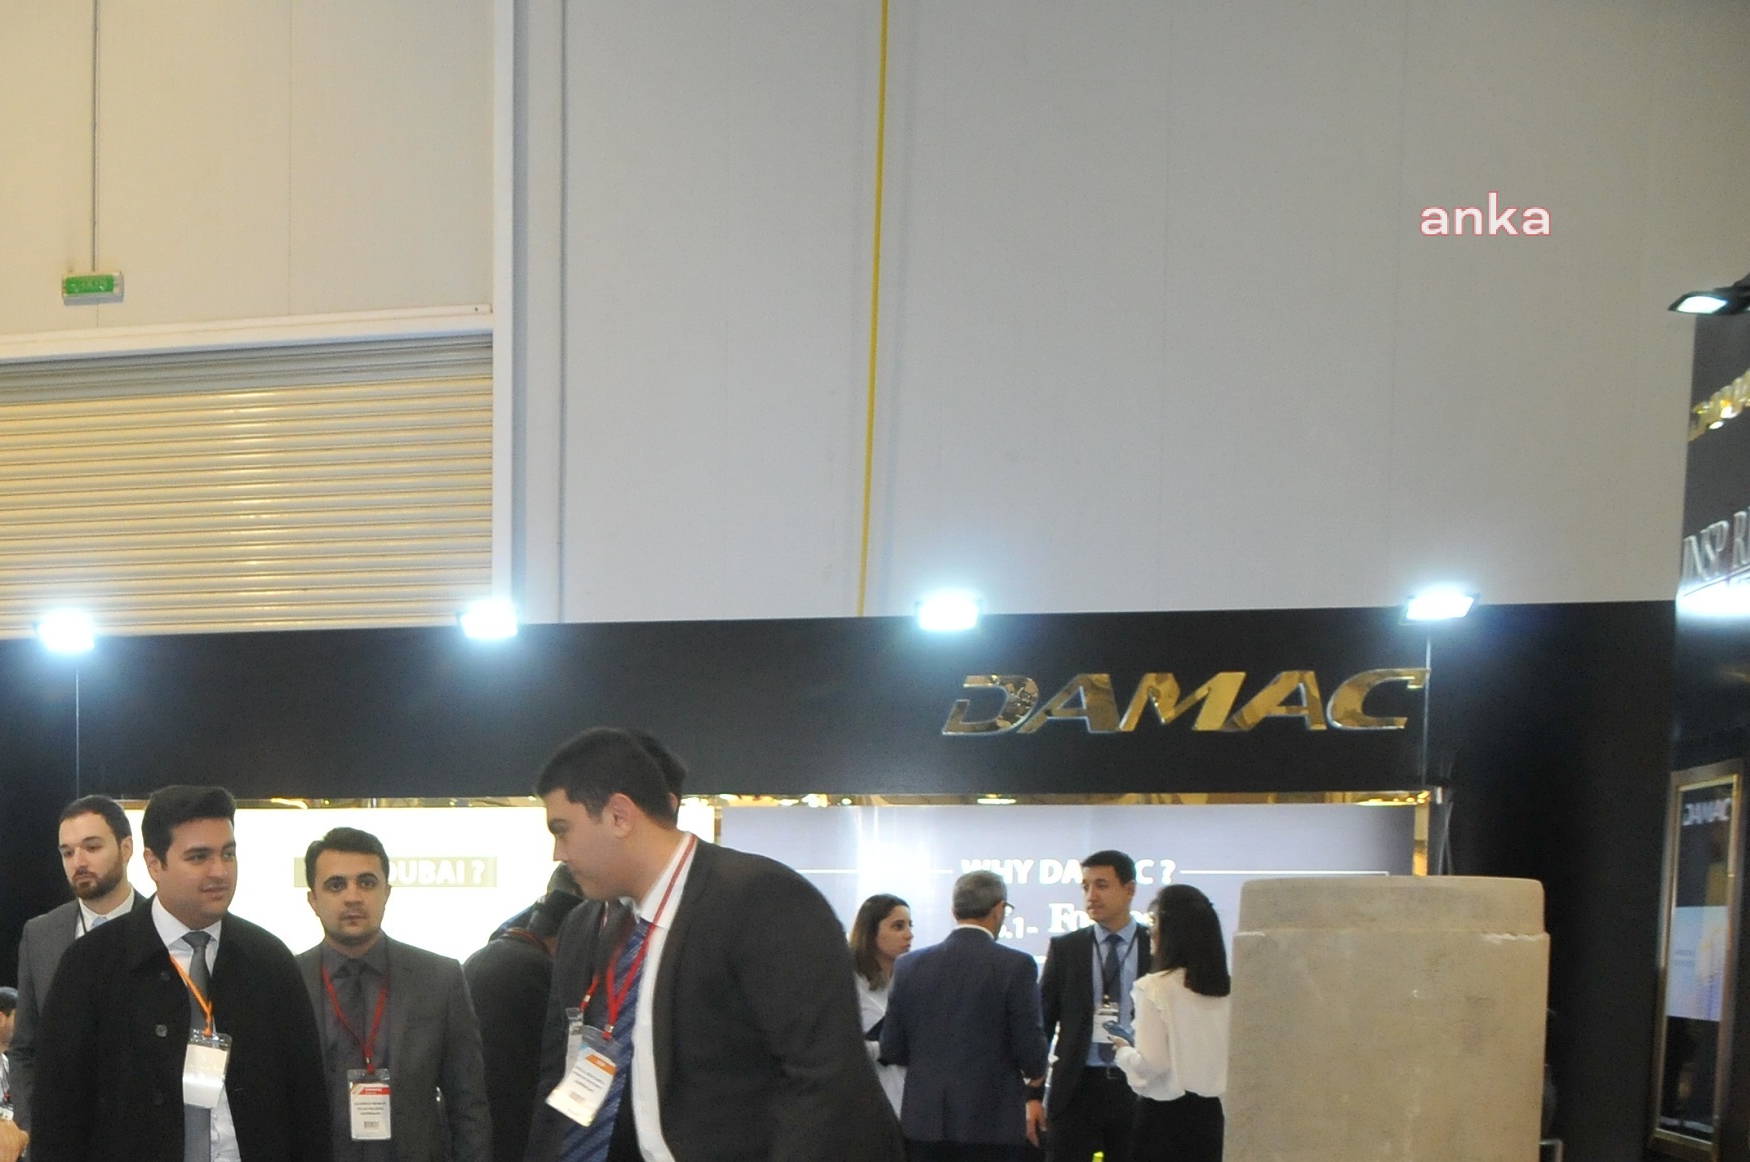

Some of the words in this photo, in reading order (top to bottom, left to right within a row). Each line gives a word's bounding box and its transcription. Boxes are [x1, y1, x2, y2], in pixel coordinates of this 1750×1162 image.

[941, 667, 1431, 735] DAMAC
[471, 859, 486, 884] ?
[1039, 859, 1155, 884] DAC
[1160, 859, 1176, 884] ?
